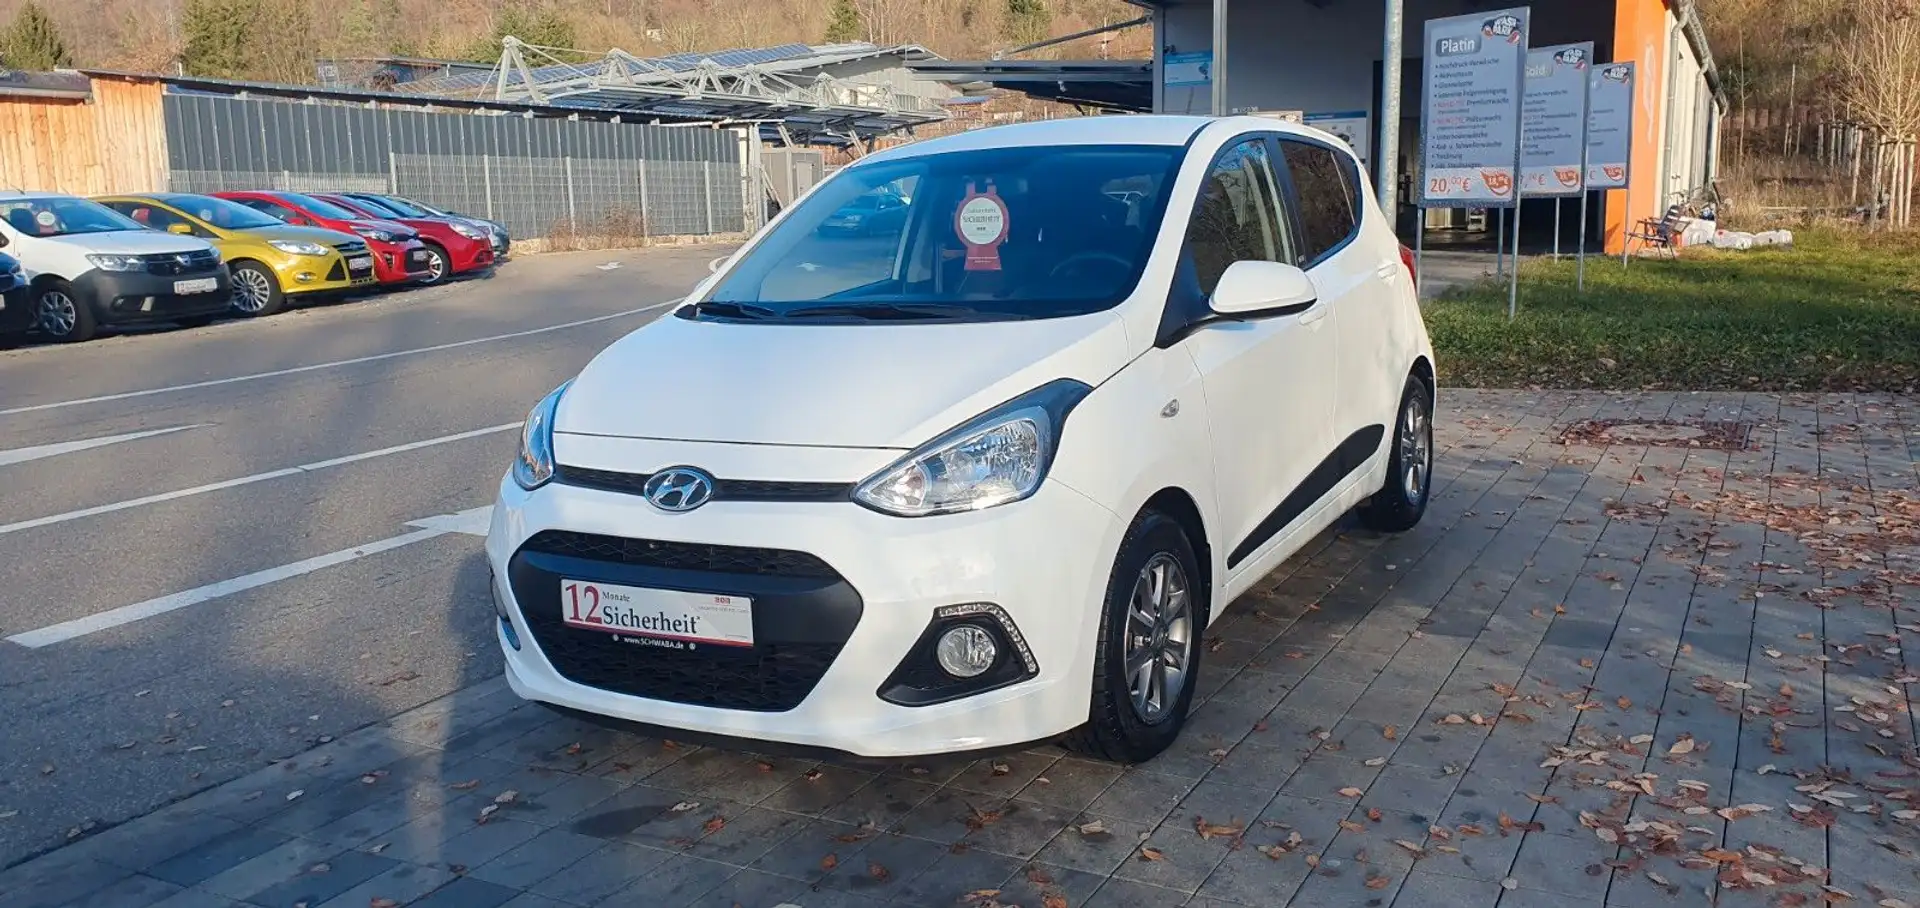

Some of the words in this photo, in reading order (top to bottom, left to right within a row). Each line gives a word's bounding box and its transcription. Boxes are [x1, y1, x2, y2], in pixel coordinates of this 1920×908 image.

[1441, 38, 1475, 53] Platin
[565, 583, 603, 625] 12
[623, 636, 684, 650] www.SCHWABA.de
